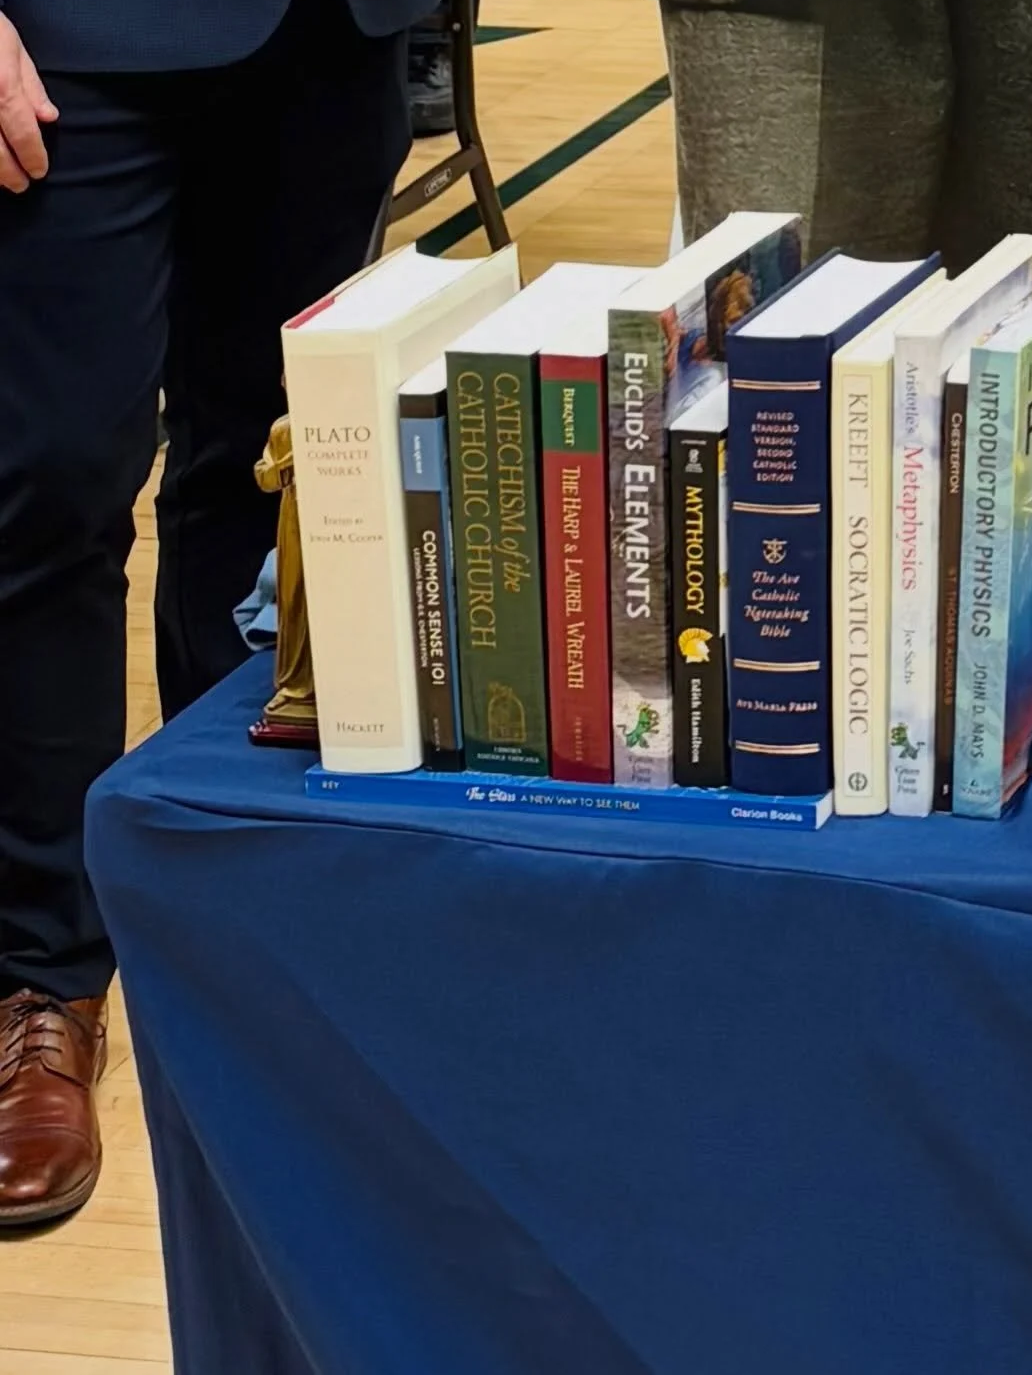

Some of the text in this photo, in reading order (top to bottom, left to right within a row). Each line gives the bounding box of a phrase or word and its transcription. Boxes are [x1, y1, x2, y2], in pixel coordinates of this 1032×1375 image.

[562, 387, 576, 448] BERQUIST
[756, 411, 795, 421] REVISED
[906, 360, 920, 436] Aristotle's
[304, 426, 371, 443] PLATO
[751, 424, 800, 433] STANDARD
[754, 436, 797, 446] VERSION,
[307, 449, 369, 461] COMPLETE
[317, 466, 362, 477] WORKS
[753, 460, 798, 470] CATHOLIC
[757, 448, 794, 458] SECOND
[950, 413, 963, 495] CHESTERTON
[493, 372, 531, 593] CATECHISM of the
[624, 352, 656, 619] EUCLID'S ELEMENTS
[756, 473, 794, 482] EDITION
[457, 371, 497, 650] CATHOLIC CHURCH
[896, 445, 926, 592] Metaphysics
[422, 529, 440, 606] COMMON
[685, 485, 705, 615] MYTHOLOGY
[848, 393, 870, 736] KREEFT SOCRATIC LOGIC
[971, 373, 1000, 759] INTRODUCTORY PHYSICS JOHN D. MAYS
[562, 464, 585, 690] THE HARP & LAUREL WREATH
[752, 570, 801, 584] The Ave
[752, 588, 801, 602] Catholic
[427, 610, 444, 658] SENSE
[760, 625, 792, 638] Bible
[903, 628, 916, 648] Joe
[947, 589, 957, 644] THOMAS
[418, 617, 428, 668] CHESTERTON
[943, 647, 955, 706] AQUINAS
[691, 677, 703, 763] Edith Hamilton
[322, 780, 340, 790] REY
[530, 795, 553, 805] NEW
[556, 796, 577, 805] WAY
[580, 798, 593, 807] TO
[596, 799, 612, 809] SEE
[615, 801, 640, 810] THEM
[731, 807, 803, 822] Clarion Books
